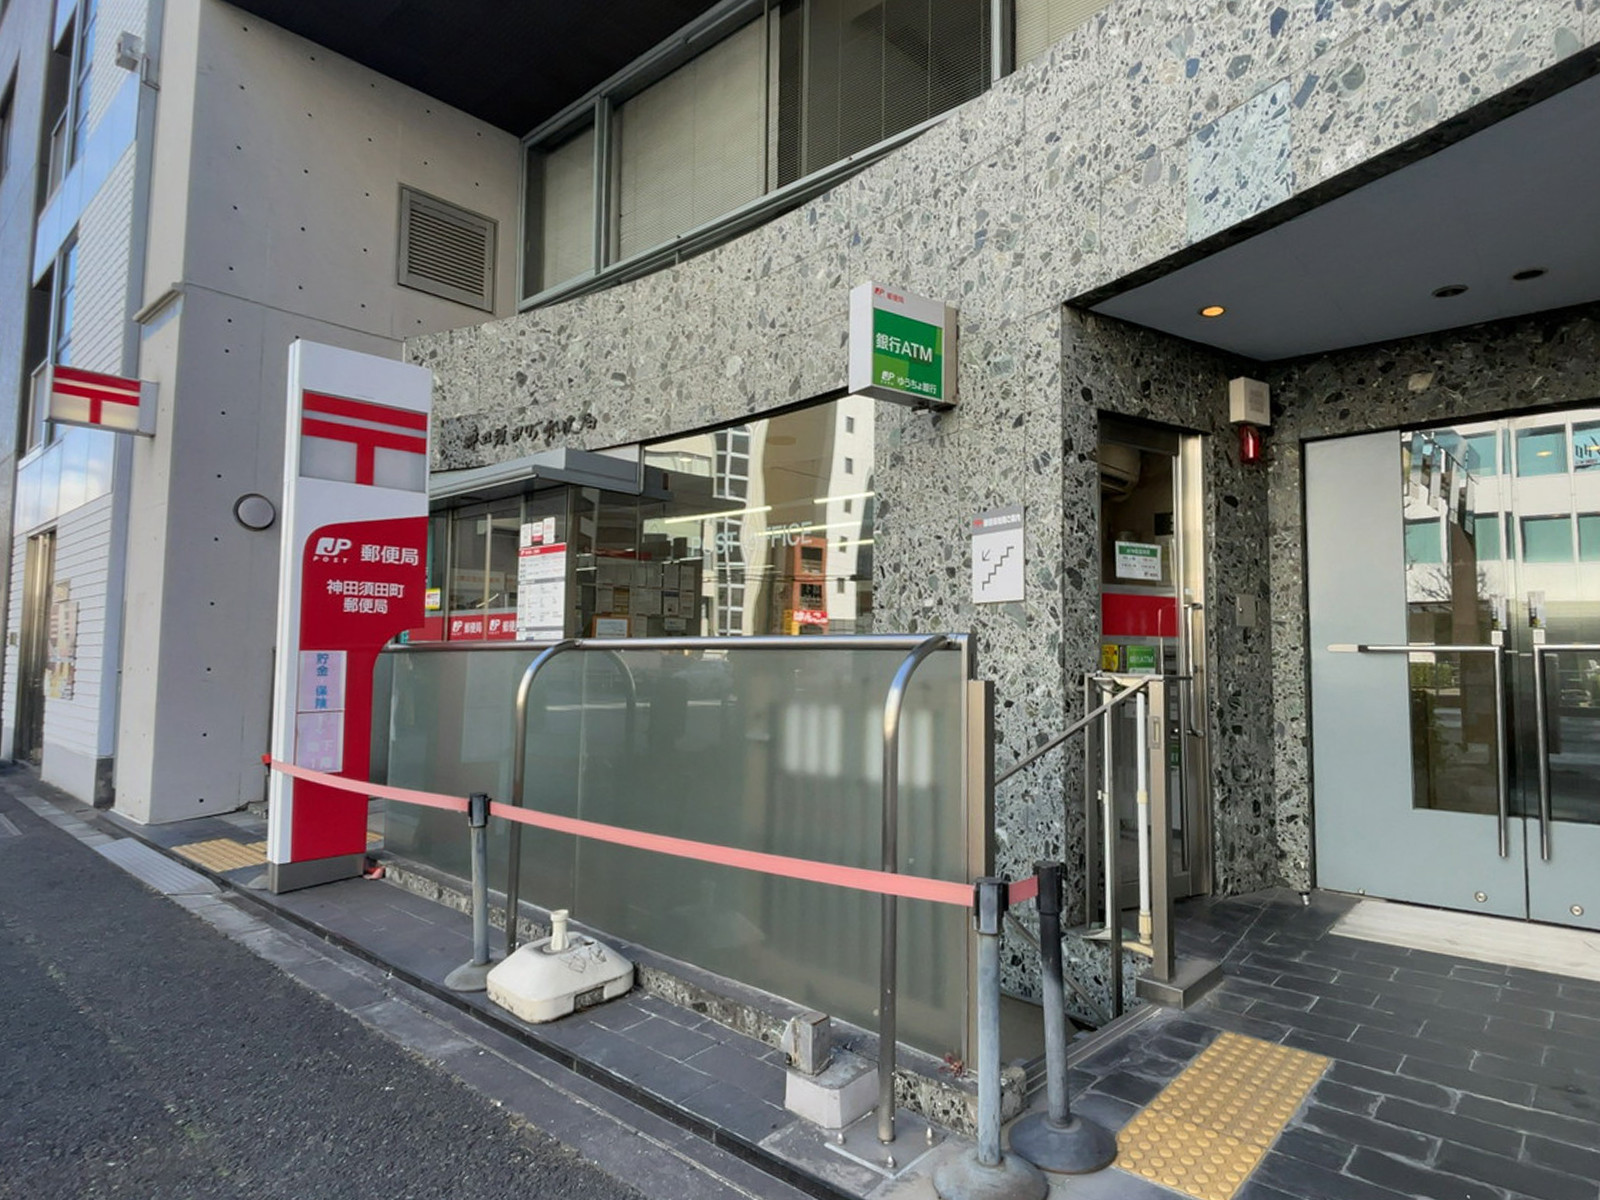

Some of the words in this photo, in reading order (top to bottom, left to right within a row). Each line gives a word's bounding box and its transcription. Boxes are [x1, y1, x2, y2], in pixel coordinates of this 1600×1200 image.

[876, 332, 932, 362] 銀行ATM
[757, 520, 812, 548] FFICE
[312, 555, 348, 564] POST
[315, 536, 352, 556] JP
[360, 543, 419, 567] 郵便局
[326, 578, 405, 598] 神田須田町
[342, 596, 388, 614] 郵便局
